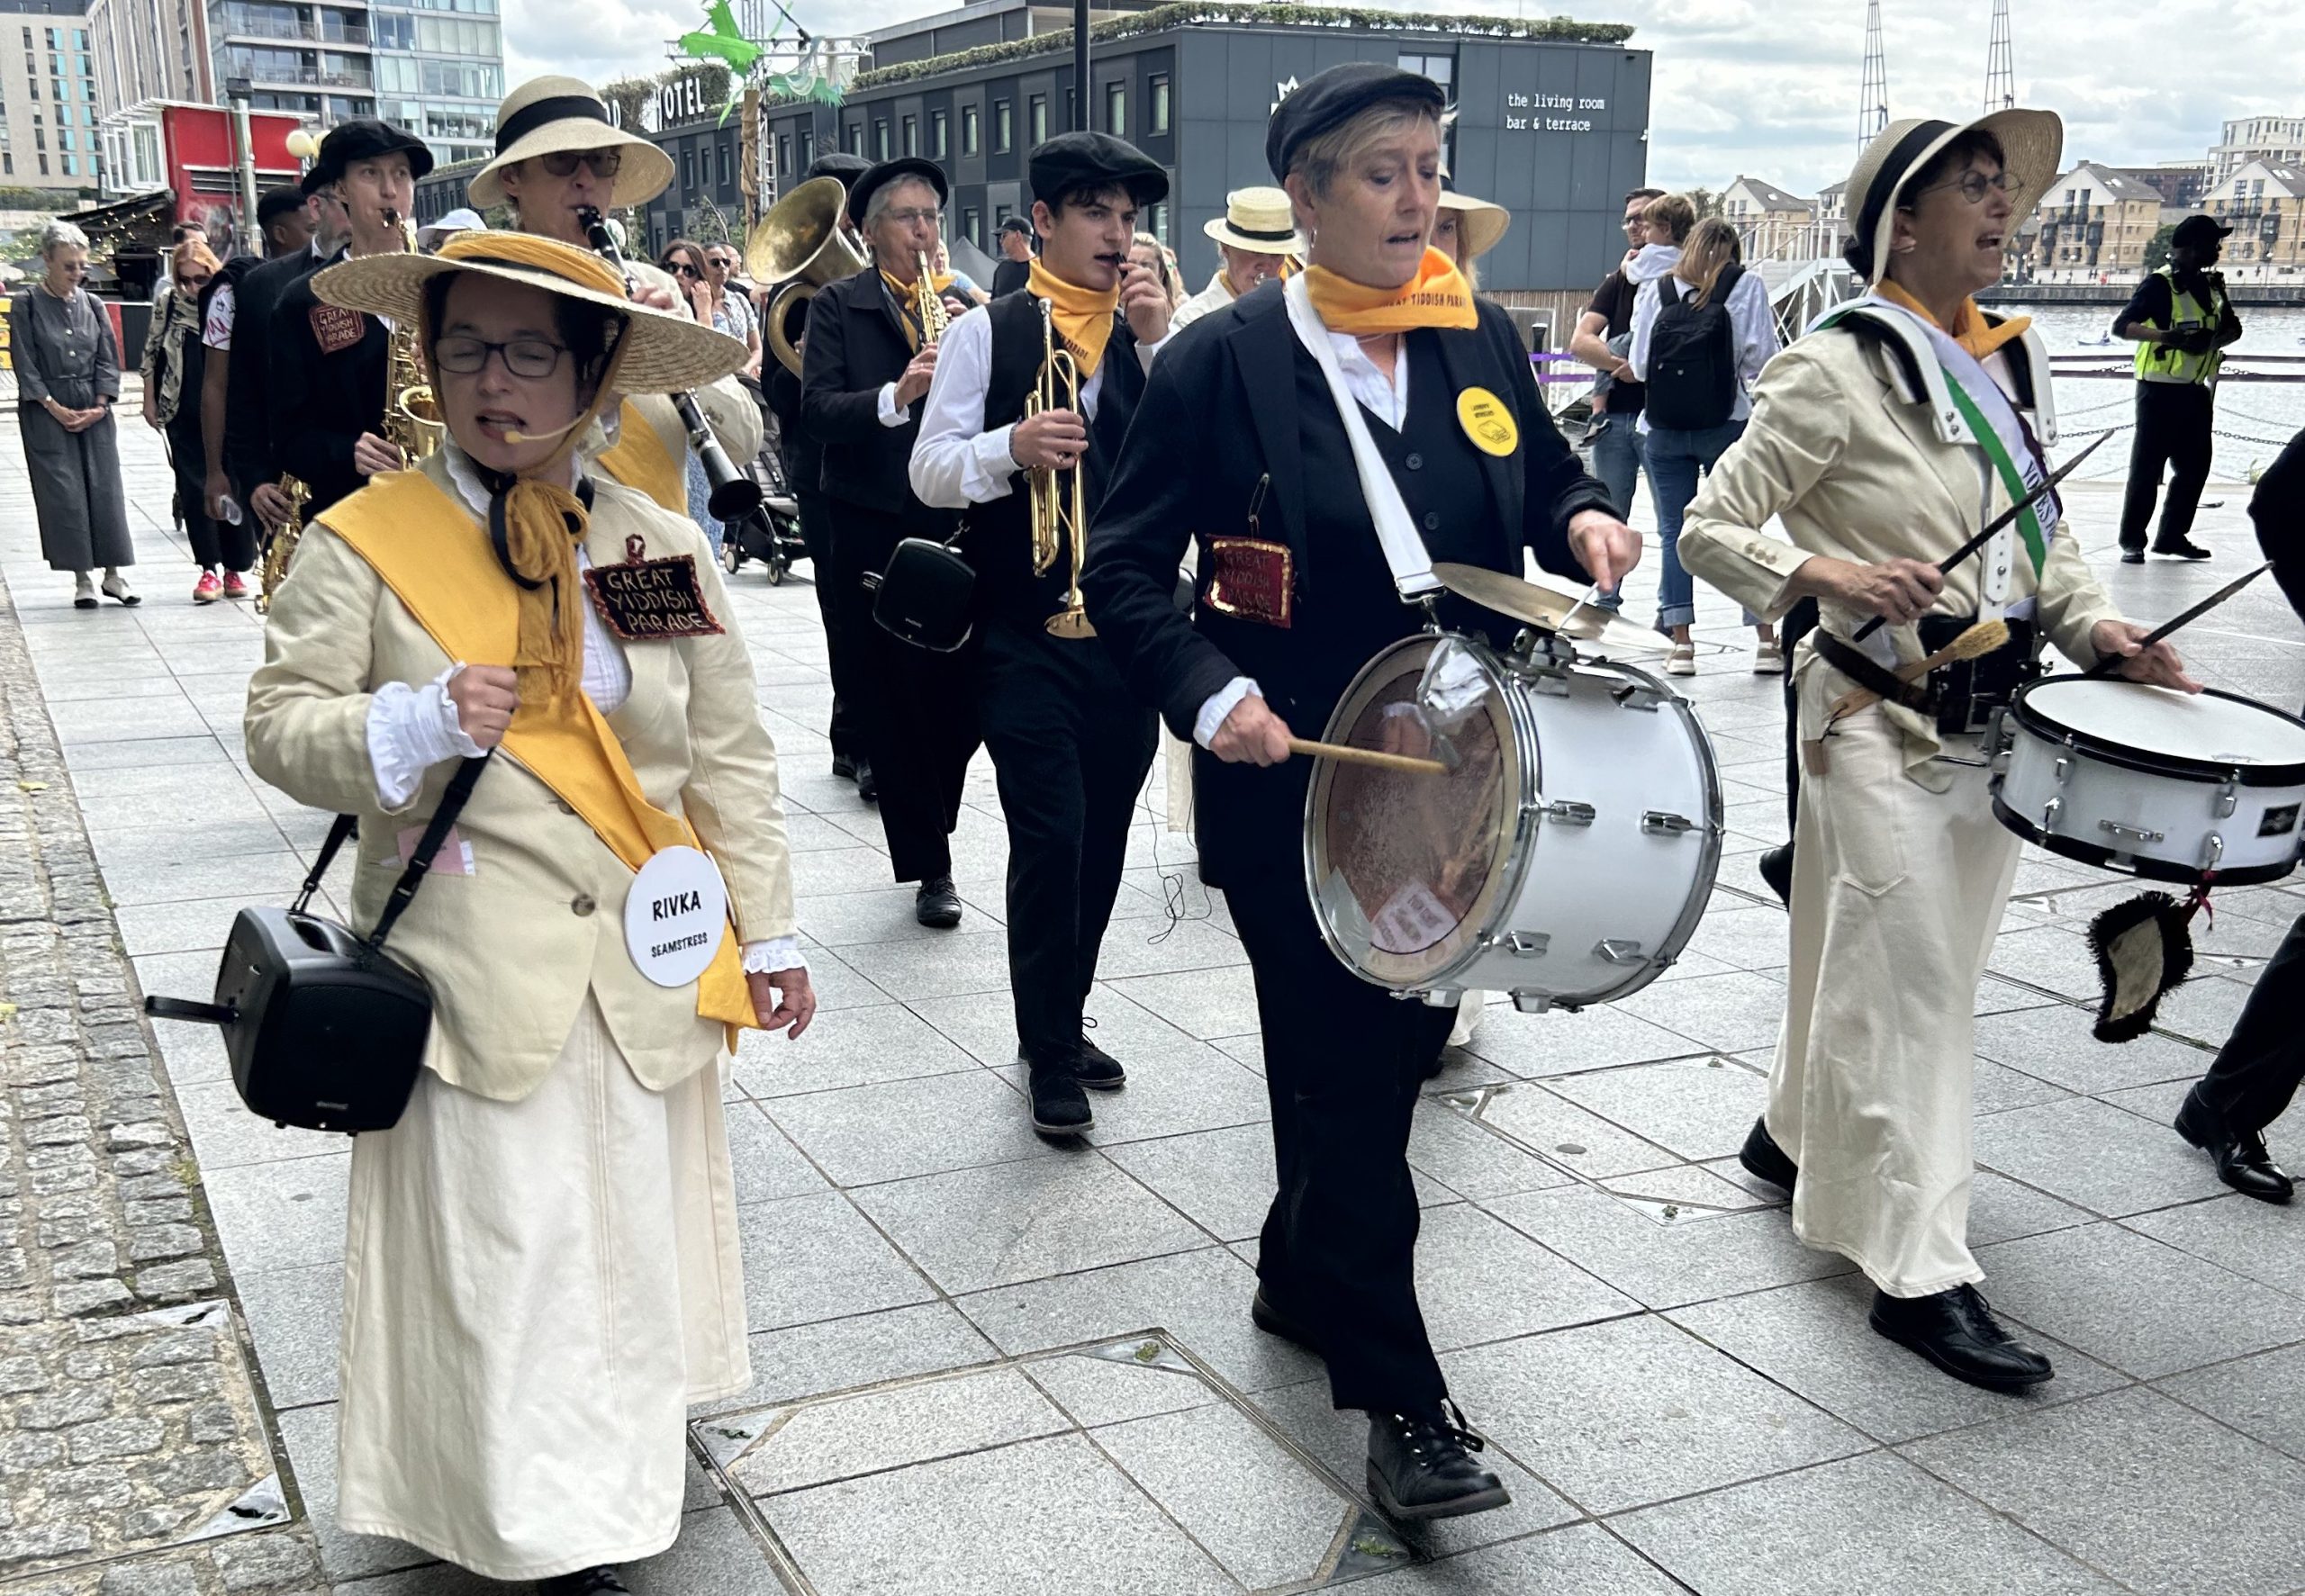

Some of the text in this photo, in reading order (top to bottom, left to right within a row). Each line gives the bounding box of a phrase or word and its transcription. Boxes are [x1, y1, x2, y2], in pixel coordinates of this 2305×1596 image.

[653, 77, 705, 131] HOTEL
[1507, 93, 1605, 112] the living room
[1506, 114, 1591, 131] bar & terrace
[2022, 460, 2054, 523] VOES
[1225, 550, 1271, 569] GREAT
[606, 568, 673, 591] GREAT
[606, 590, 693, 611] YIDDISH
[625, 612, 710, 633] PARADE
[652, 890, 701, 922] RIVKA
[651, 932, 709, 958] SEAMSTRESS
